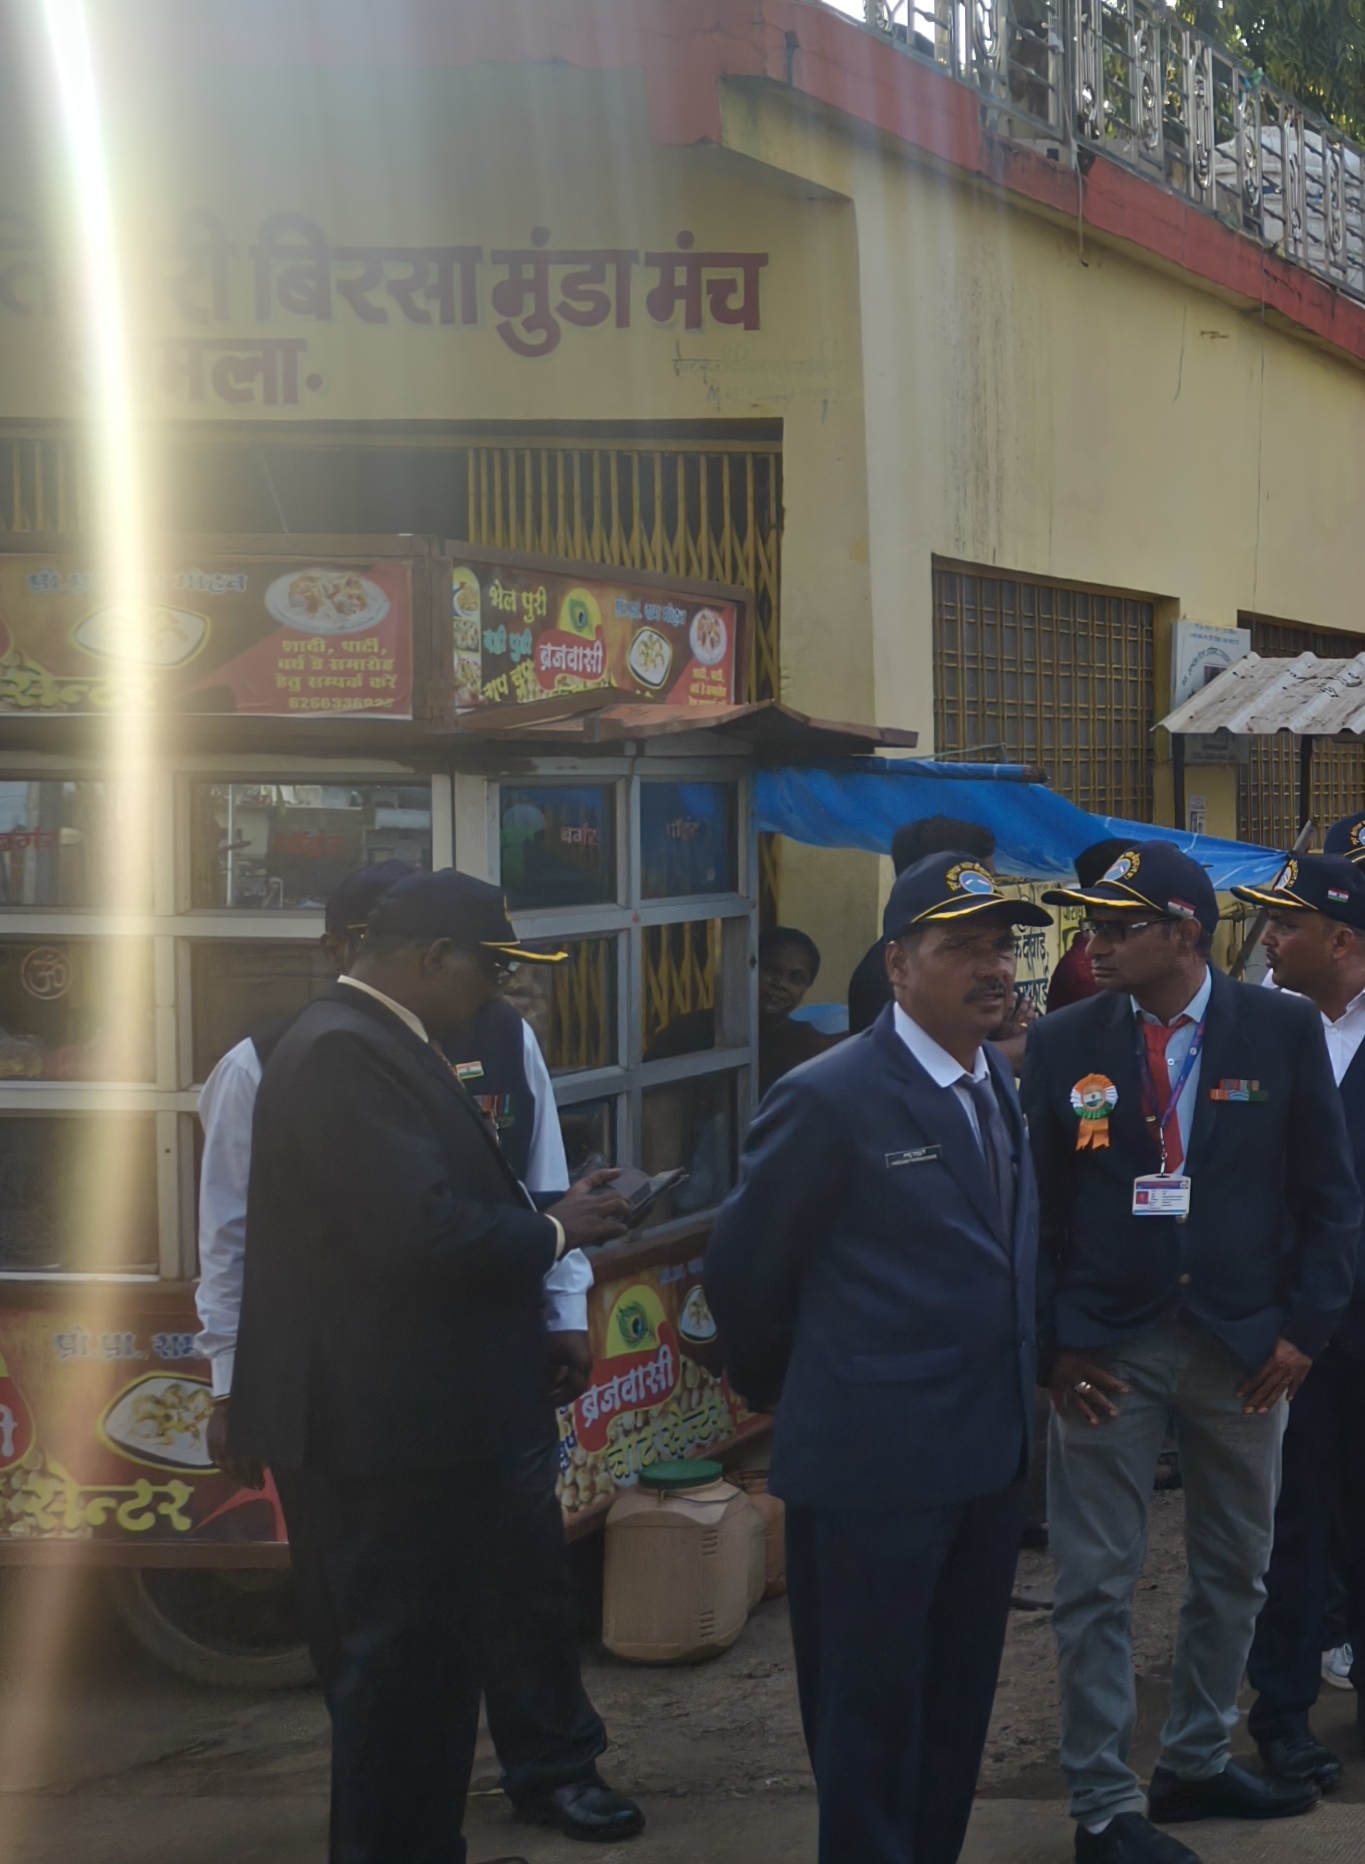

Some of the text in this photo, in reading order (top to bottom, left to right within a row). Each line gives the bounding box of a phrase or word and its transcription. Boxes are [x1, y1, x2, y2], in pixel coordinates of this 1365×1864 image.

[250, 212, 769, 358] बिरसा मुंडा मंच
[489, 579, 547, 623] भेल पुरी
[540, 641, 603, 674] ब्रजवासी
[581, 1344, 674, 1428] ब्रजवासी
[21, 1457, 195, 1532] सेन्टर
